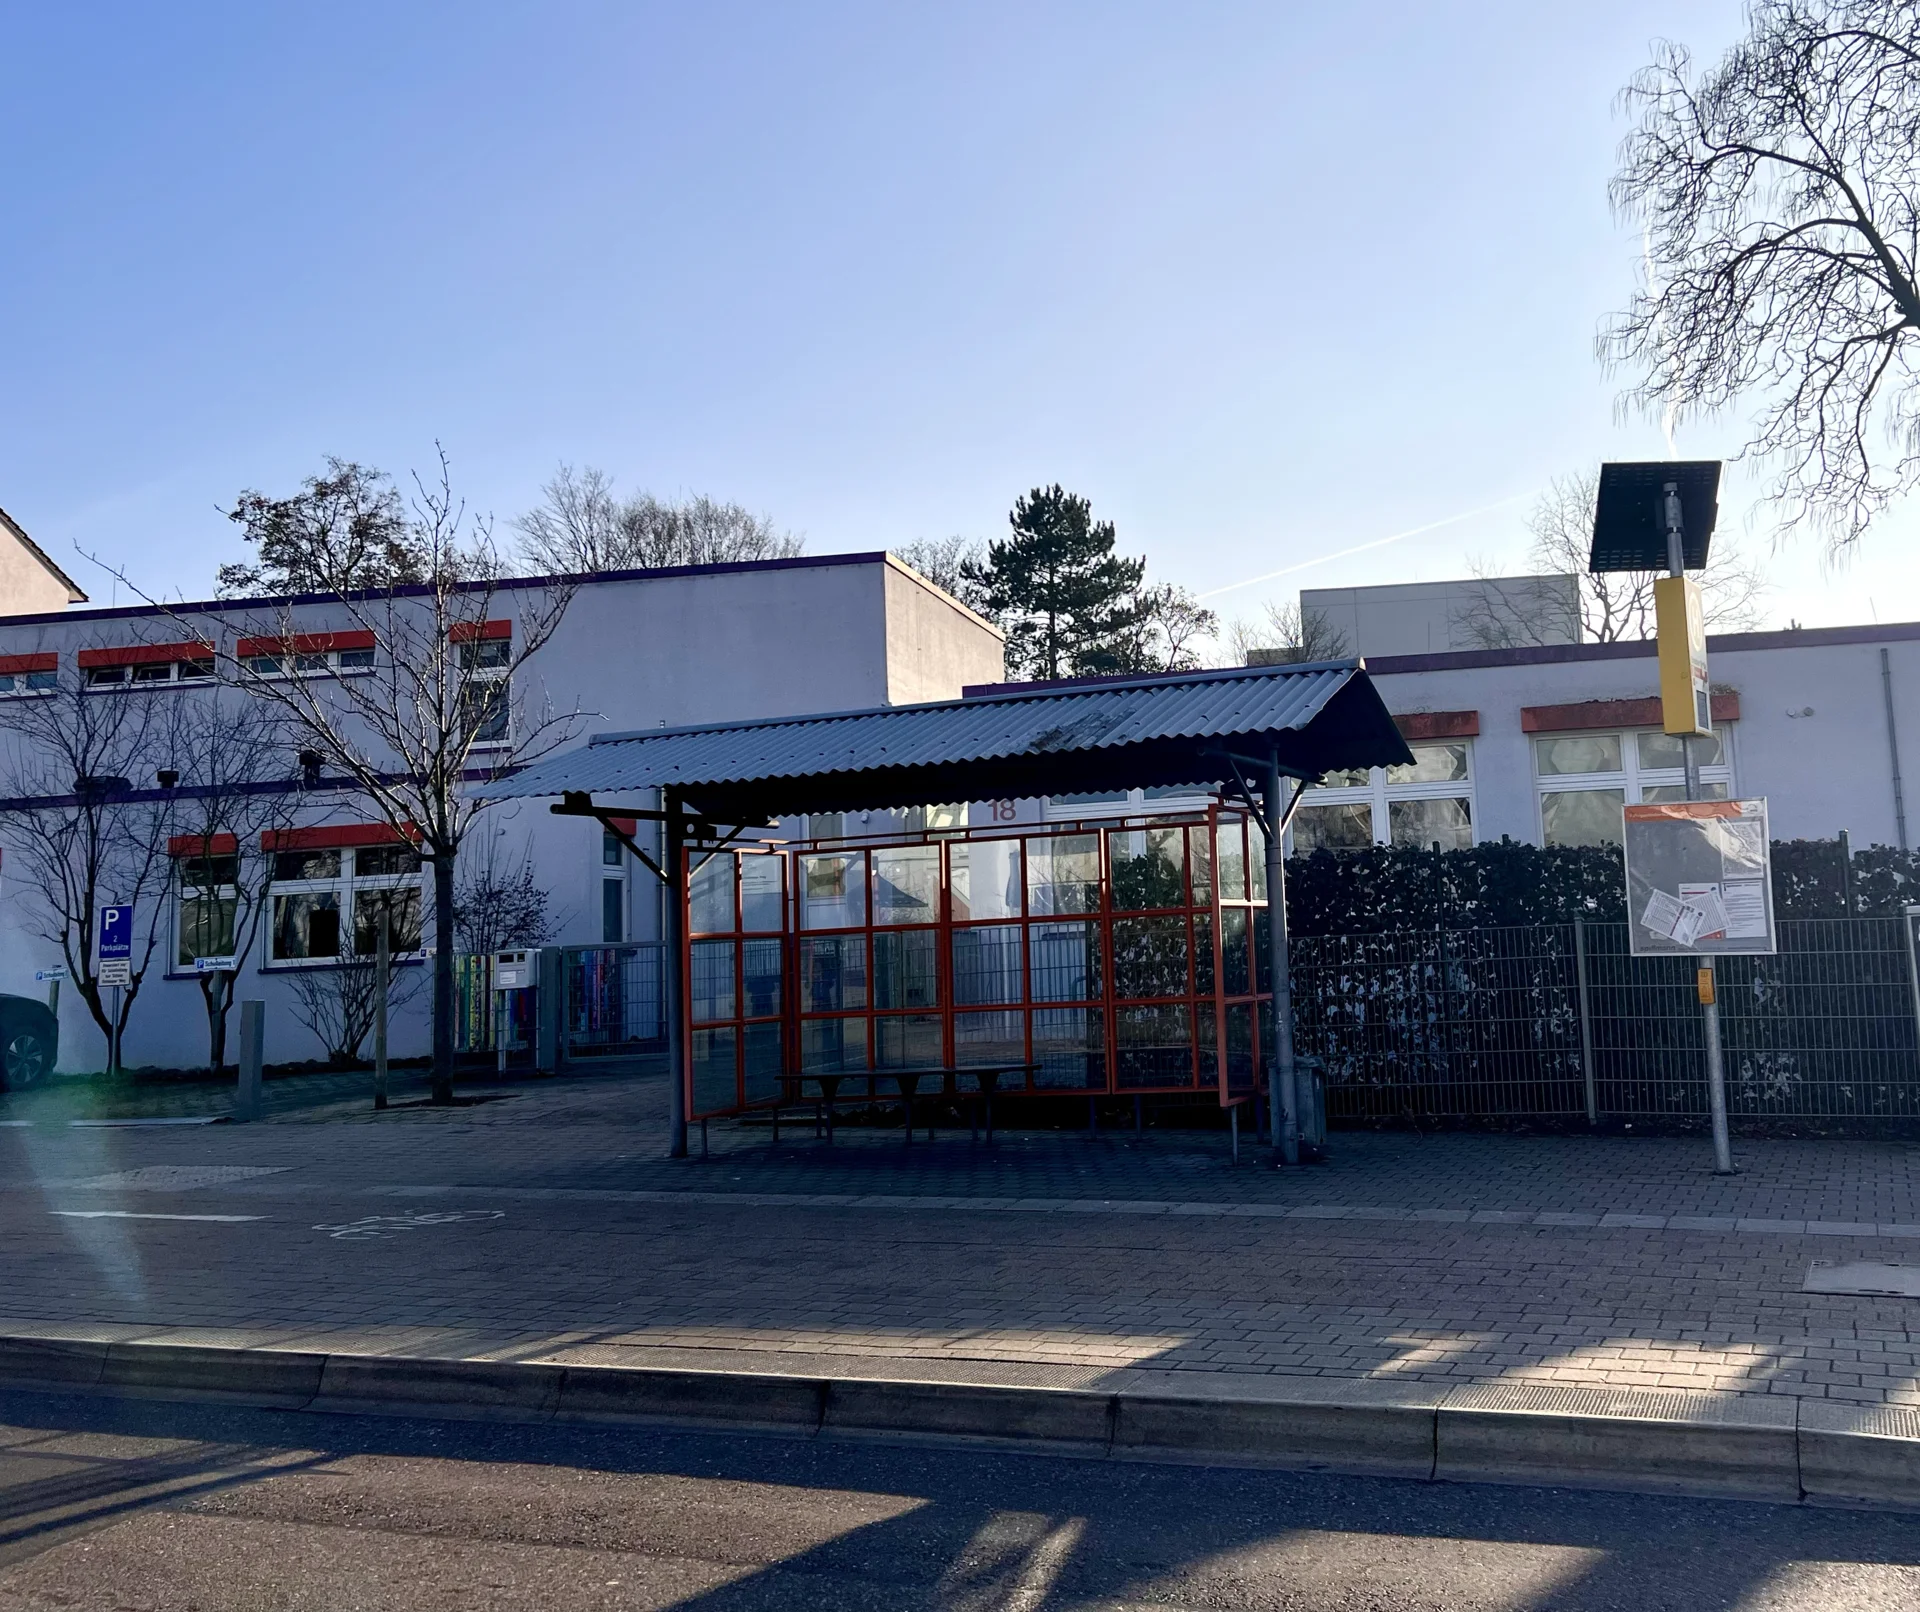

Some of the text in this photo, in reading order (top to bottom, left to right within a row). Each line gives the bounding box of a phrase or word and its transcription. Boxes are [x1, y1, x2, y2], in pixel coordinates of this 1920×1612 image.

[988, 799, 1016, 821] 18
[105, 909, 119, 930] P
[101, 944, 129, 952] Parkplätze
